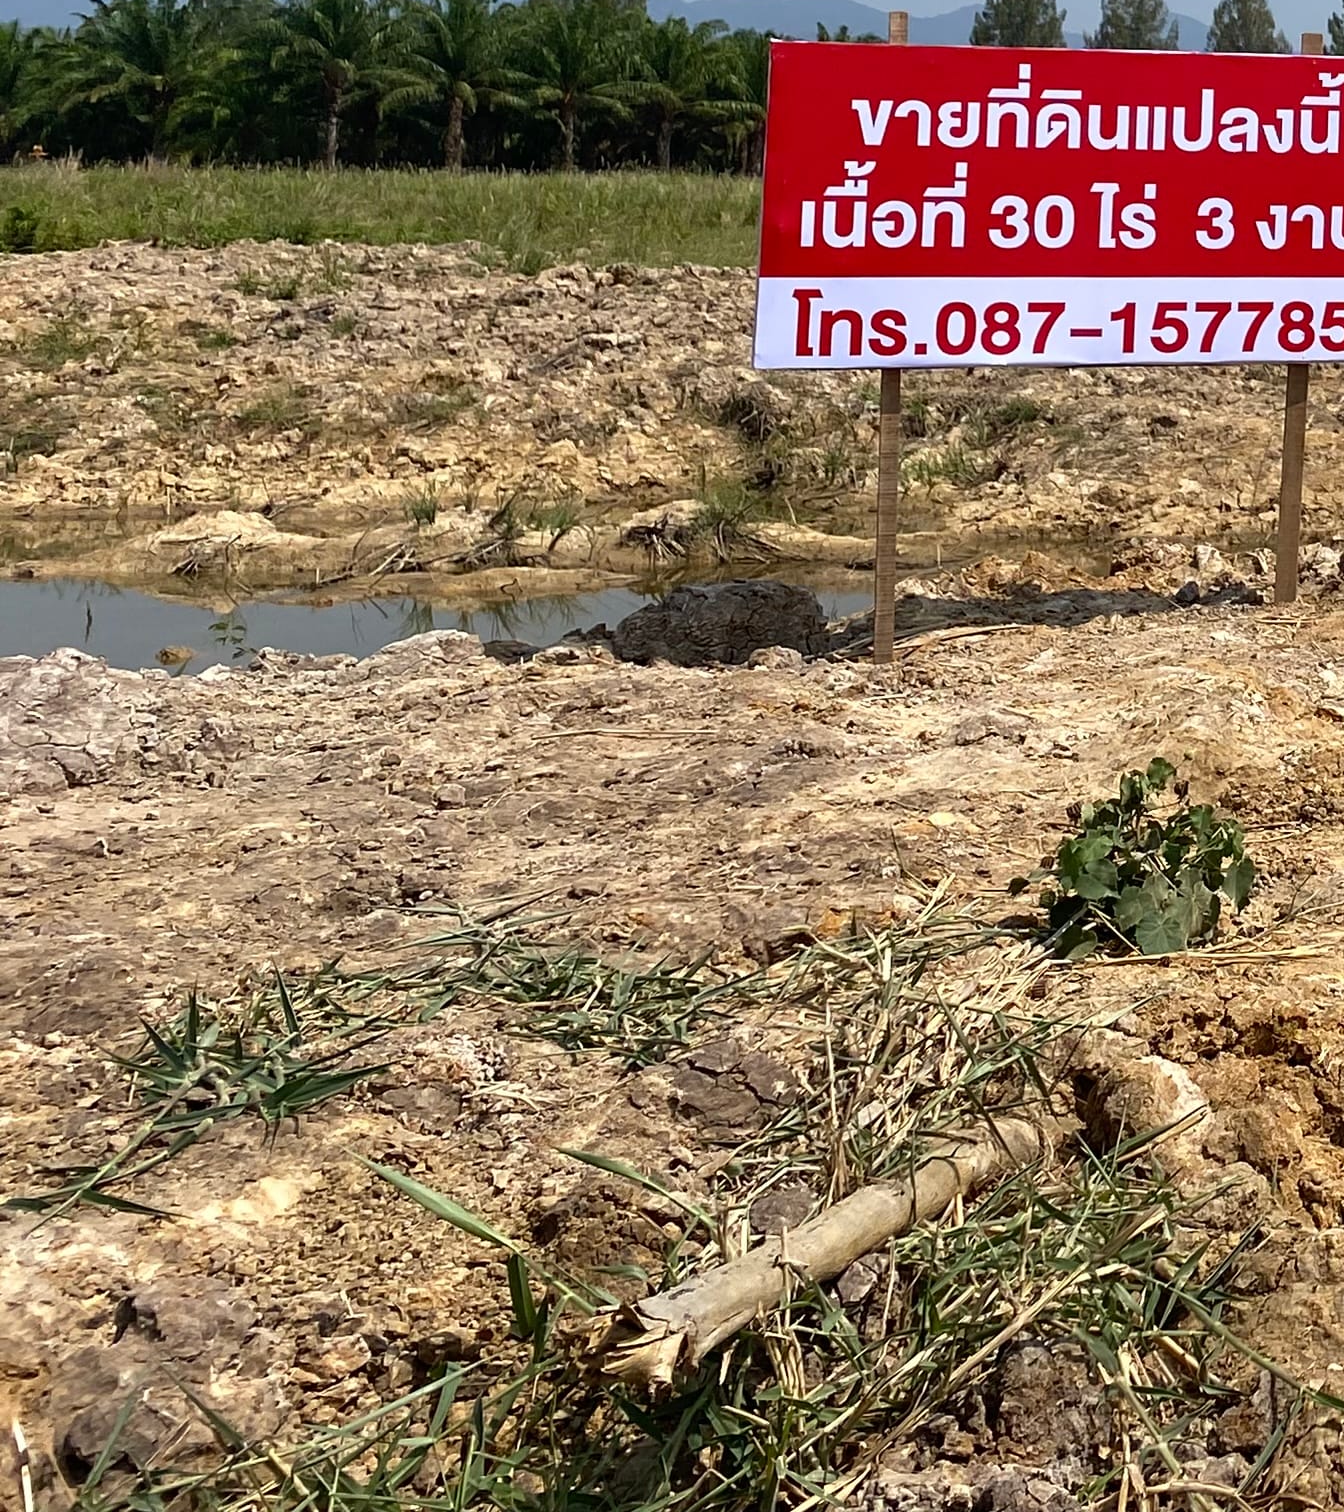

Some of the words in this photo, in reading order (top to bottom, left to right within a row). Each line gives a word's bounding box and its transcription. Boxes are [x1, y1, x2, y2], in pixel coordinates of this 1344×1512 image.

[801, 161, 967, 248] เนื้อที่
[989, 195, 1074, 248] 30
[1091, 183, 1156, 249] ไร่
[1196, 198, 1234, 249] 3
